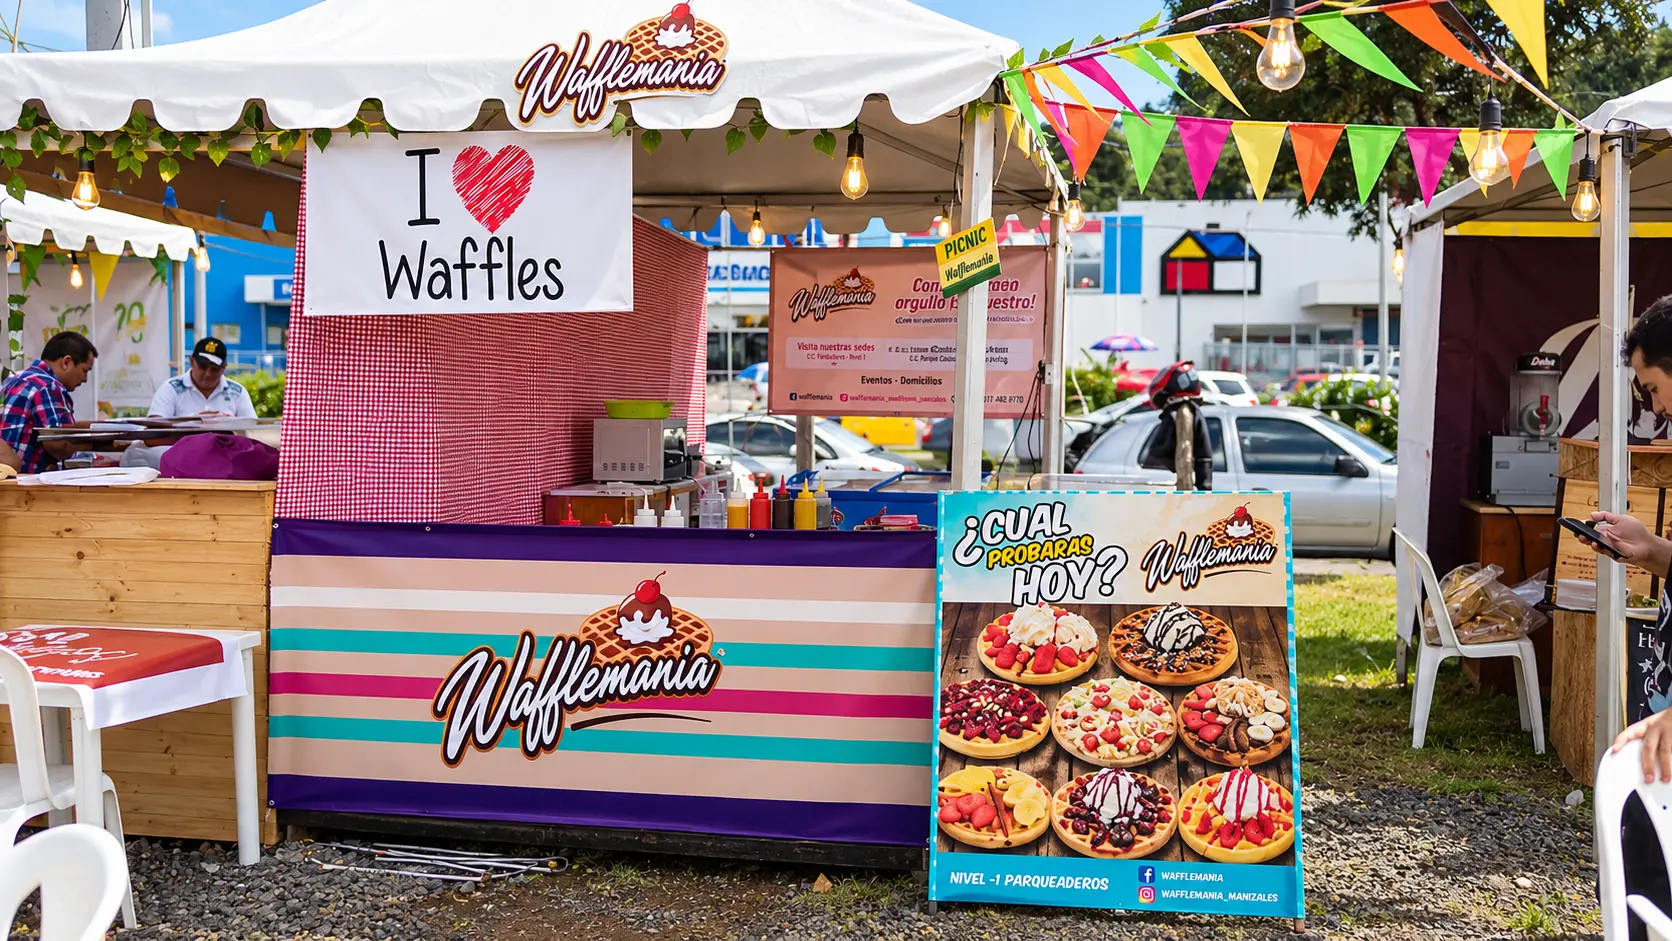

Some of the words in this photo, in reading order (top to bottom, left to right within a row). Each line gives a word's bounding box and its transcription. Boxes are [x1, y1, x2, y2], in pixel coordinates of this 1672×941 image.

[516, 32, 724, 122] Wafflemania
[405, 148, 440, 226] I
[944, 226, 987, 259] PICNIC
[379, 236, 564, 300] Waffles
[789, 283, 876, 322] Wafflemania
[895, 295, 945, 313] orgullo
[797, 342, 818, 351] Visita
[854, 343, 875, 352] sedes
[861, 376, 893, 385] Eventos
[900, 376, 942, 385] Domicilios
[954, 502, 1070, 565] ¿CUAL
[987, 534, 1094, 568] PROBARAS
[1012, 545, 1128, 606] HOY?
[1142, 532, 1278, 592] Wafflemania
[434, 631, 720, 764] Wafflemania
[950, 871, 986, 885] NIVEL
[989, 873, 1001, 886] -1
[1004, 873, 1110, 891] PARQUEADEROS
[1161, 871, 1224, 883] WAFFLEMANIA
[1161, 889, 1278, 903] WAFFLEMANIA_MANIZALES
